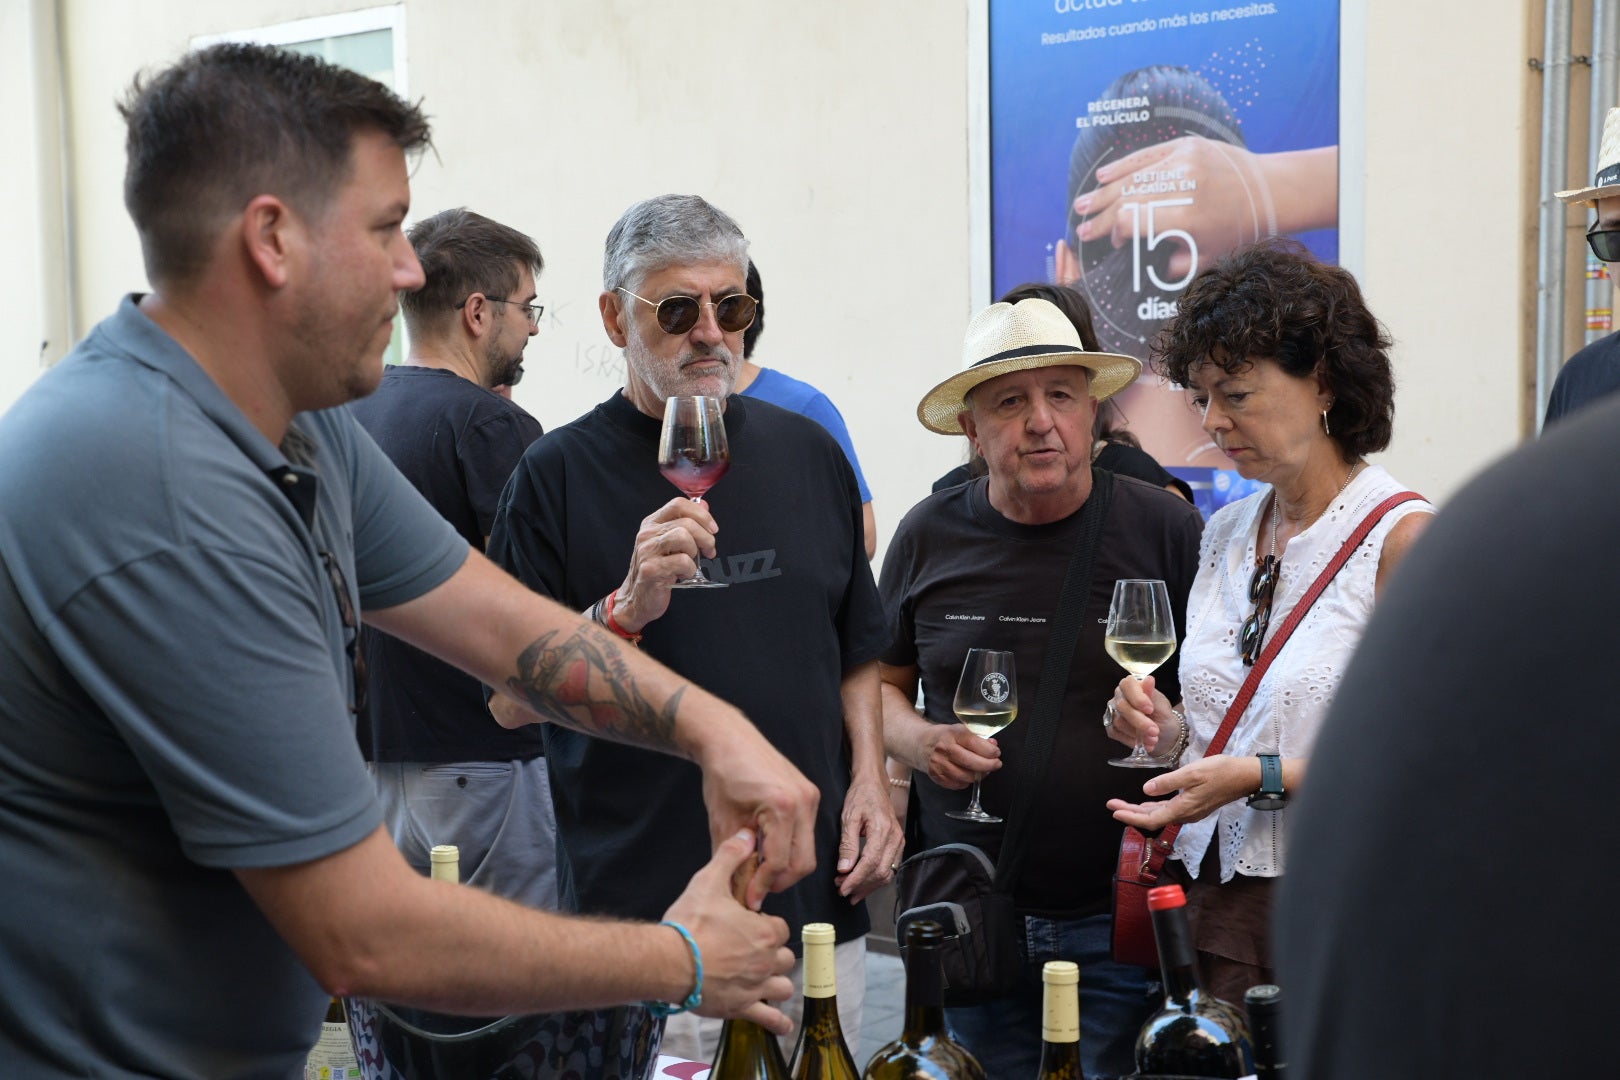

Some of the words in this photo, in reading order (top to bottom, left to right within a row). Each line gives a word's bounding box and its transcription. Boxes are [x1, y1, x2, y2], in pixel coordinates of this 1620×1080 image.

[1041, 26, 1106, 45] Resultados
[1108, 18, 1157, 36] cuando
[1159, 13, 1188, 28] más
[1189, 11, 1209, 24] los
[1211, 2, 1278, 22] necesitas.
[1087, 95, 1150, 113] REGENERA
[1076, 116, 1090, 128] EL
[1092, 109, 1150, 127] FOLÍCULO
[1180, 179, 1198, 192] EN
[1123, 197, 1198, 292] 15
[1137, 297, 1178, 320] días
